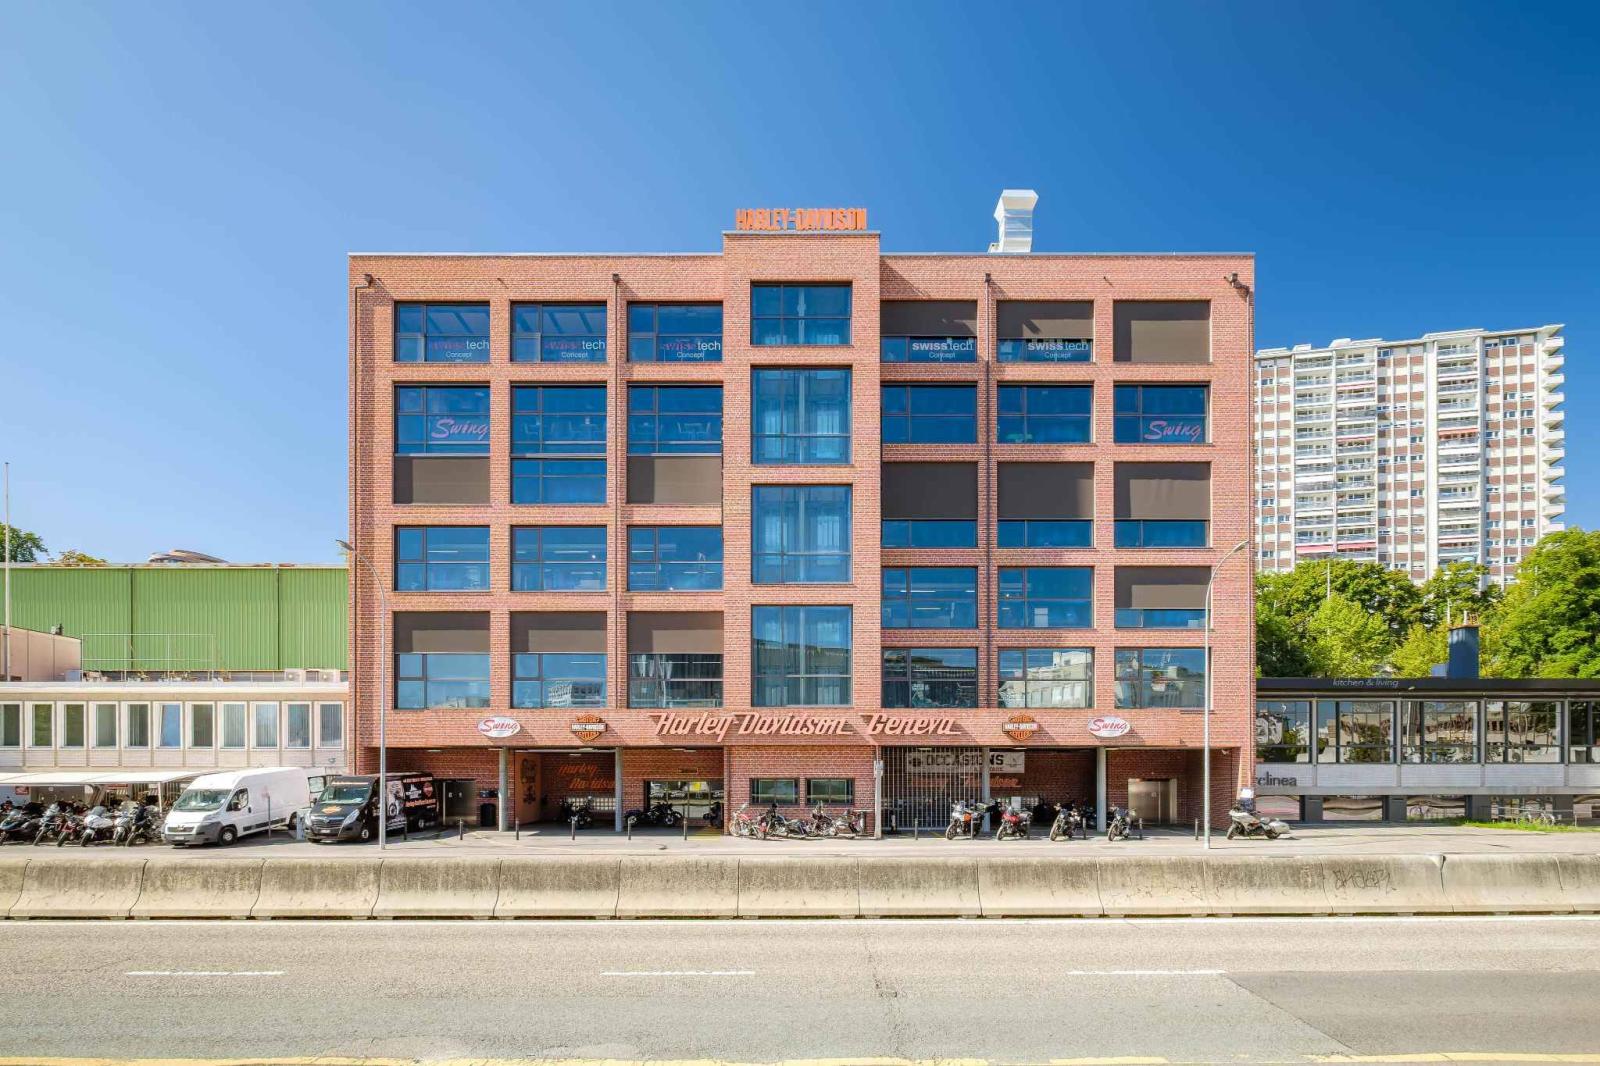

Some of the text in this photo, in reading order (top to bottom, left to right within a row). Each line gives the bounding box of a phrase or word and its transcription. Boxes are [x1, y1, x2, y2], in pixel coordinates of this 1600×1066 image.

[561, 352, 588, 360] Concept
[676, 352, 704, 360] Concept
[431, 419, 488, 440] Swing
[1144, 420, 1201, 441] Swing
[1333, 676, 1364, 686] kitchen
[1376, 676, 1399, 688] living
[480, 719, 518, 733] Swing
[859, 712, 961, 735] Geneva
[1090, 718, 1128, 733] Swing
[1256, 771, 1297, 786] clinea
